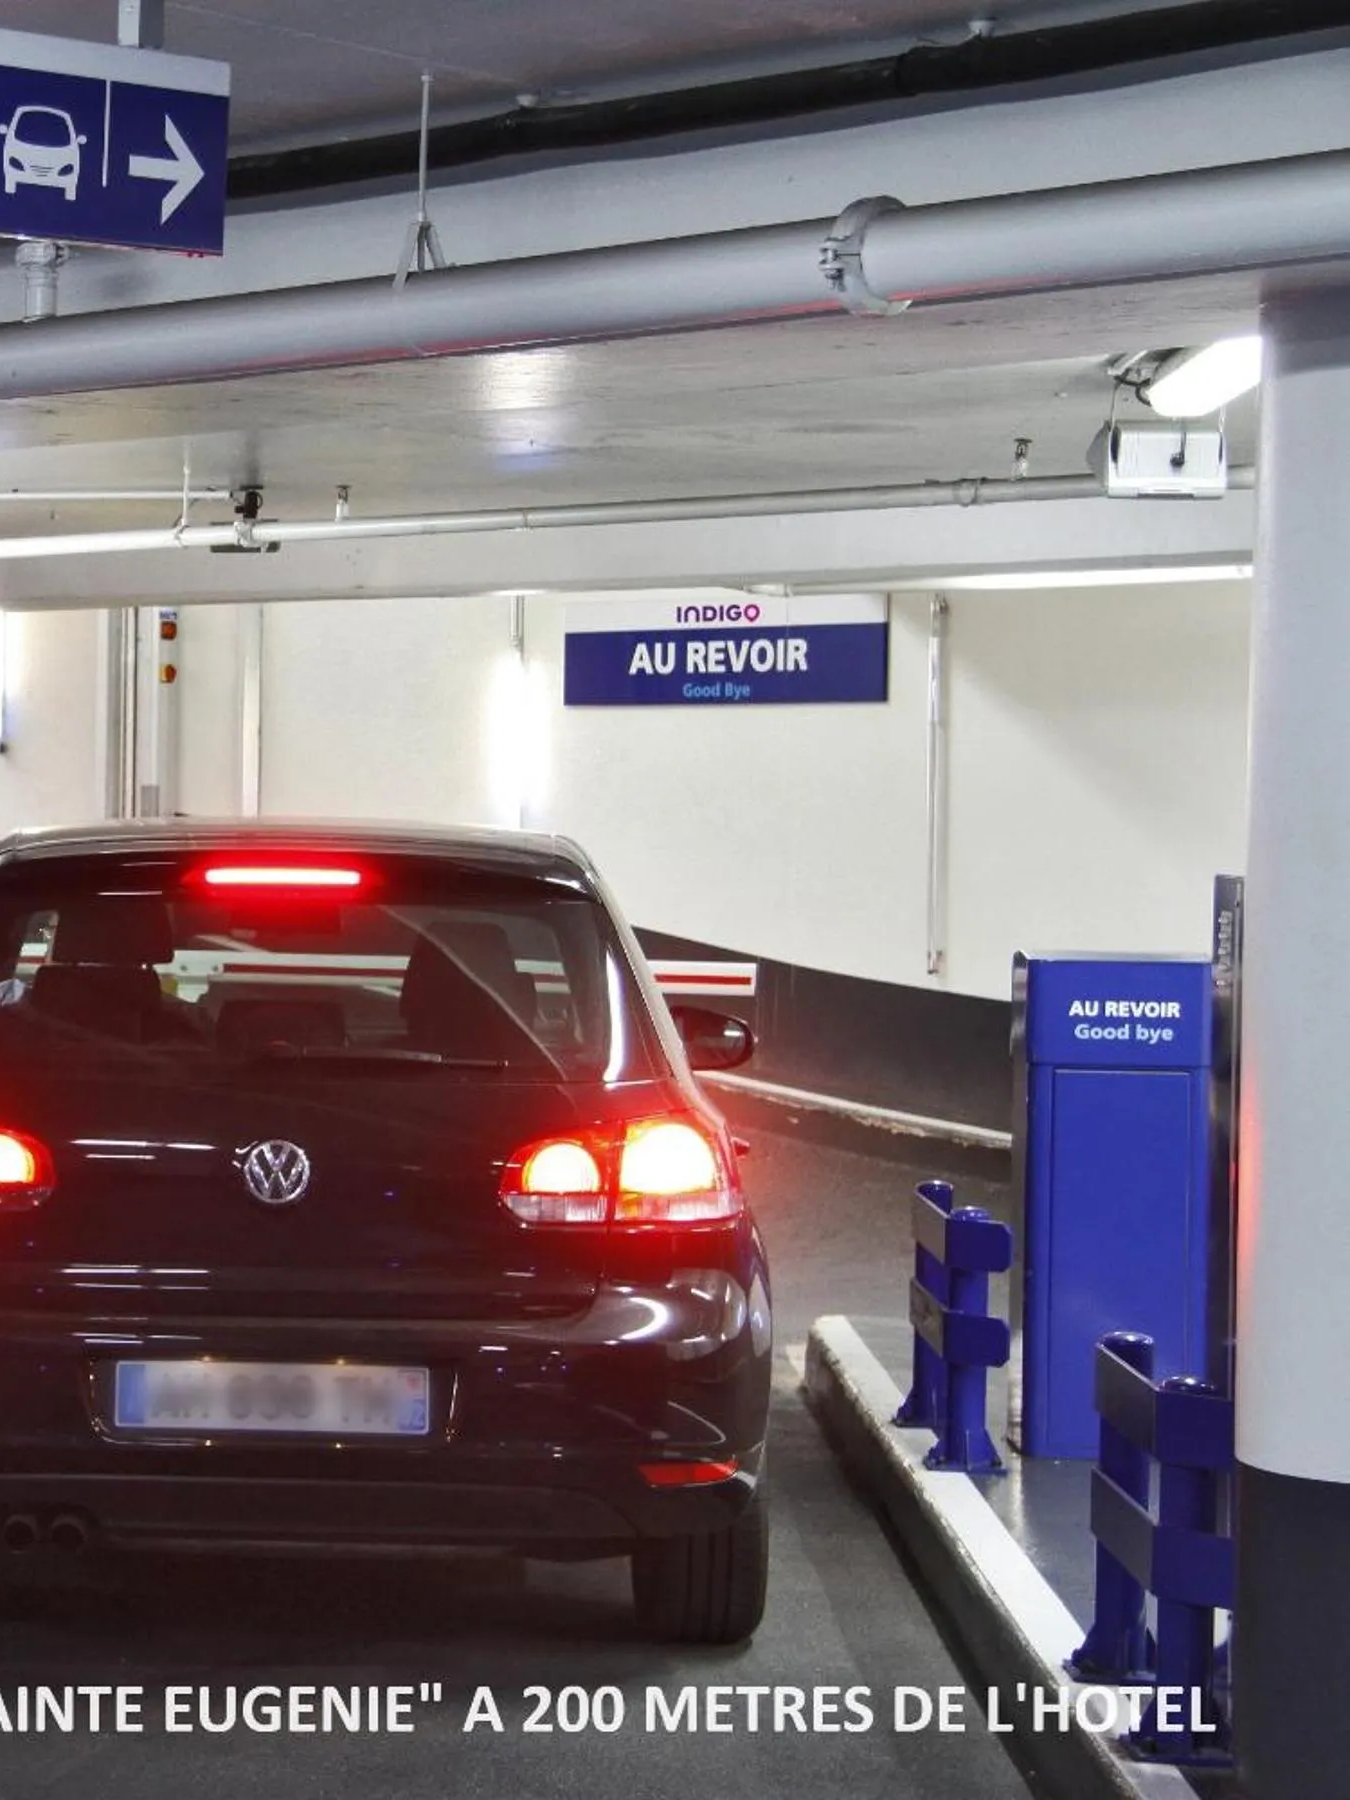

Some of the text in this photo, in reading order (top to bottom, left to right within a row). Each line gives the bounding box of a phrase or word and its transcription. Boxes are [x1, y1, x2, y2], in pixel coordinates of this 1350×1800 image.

[628, 638, 808, 675] AU REVOIR
[683, 682, 751, 699] Good Bye
[1069, 1001, 1180, 1018] AU REVOIR
[1074, 1024, 1174, 1044] Good bye
